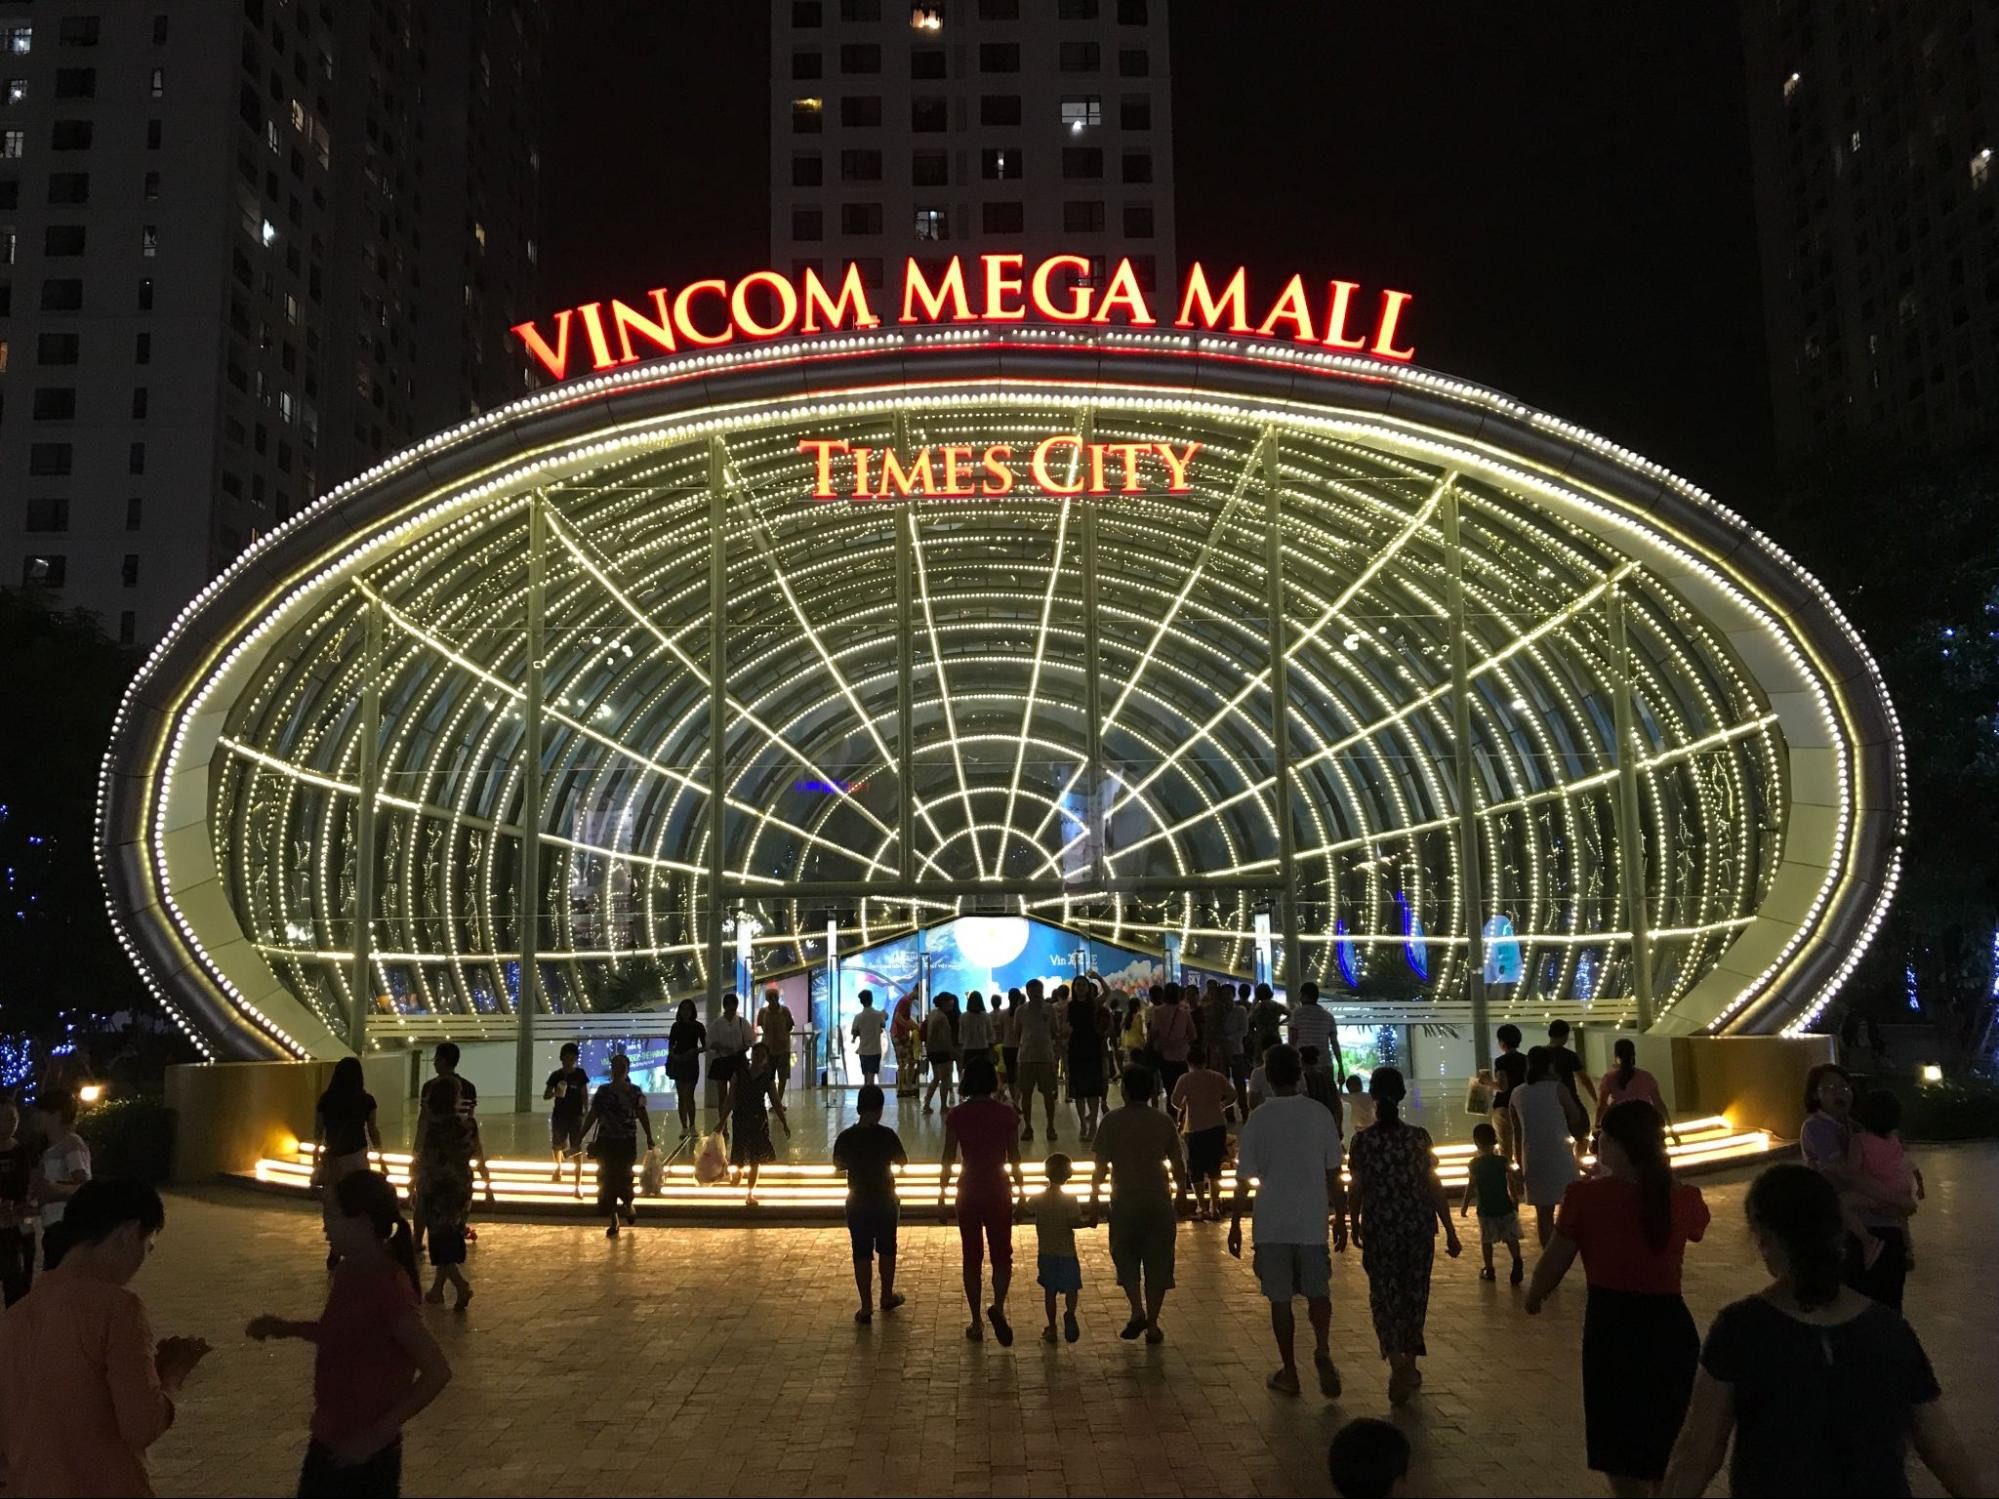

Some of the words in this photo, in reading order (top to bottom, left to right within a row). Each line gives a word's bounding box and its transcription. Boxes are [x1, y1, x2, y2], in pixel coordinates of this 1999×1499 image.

[510, 261, 881, 380] VINCOM
[898, 253, 1156, 325] MEGA
[1174, 261, 1415, 360] MALL
